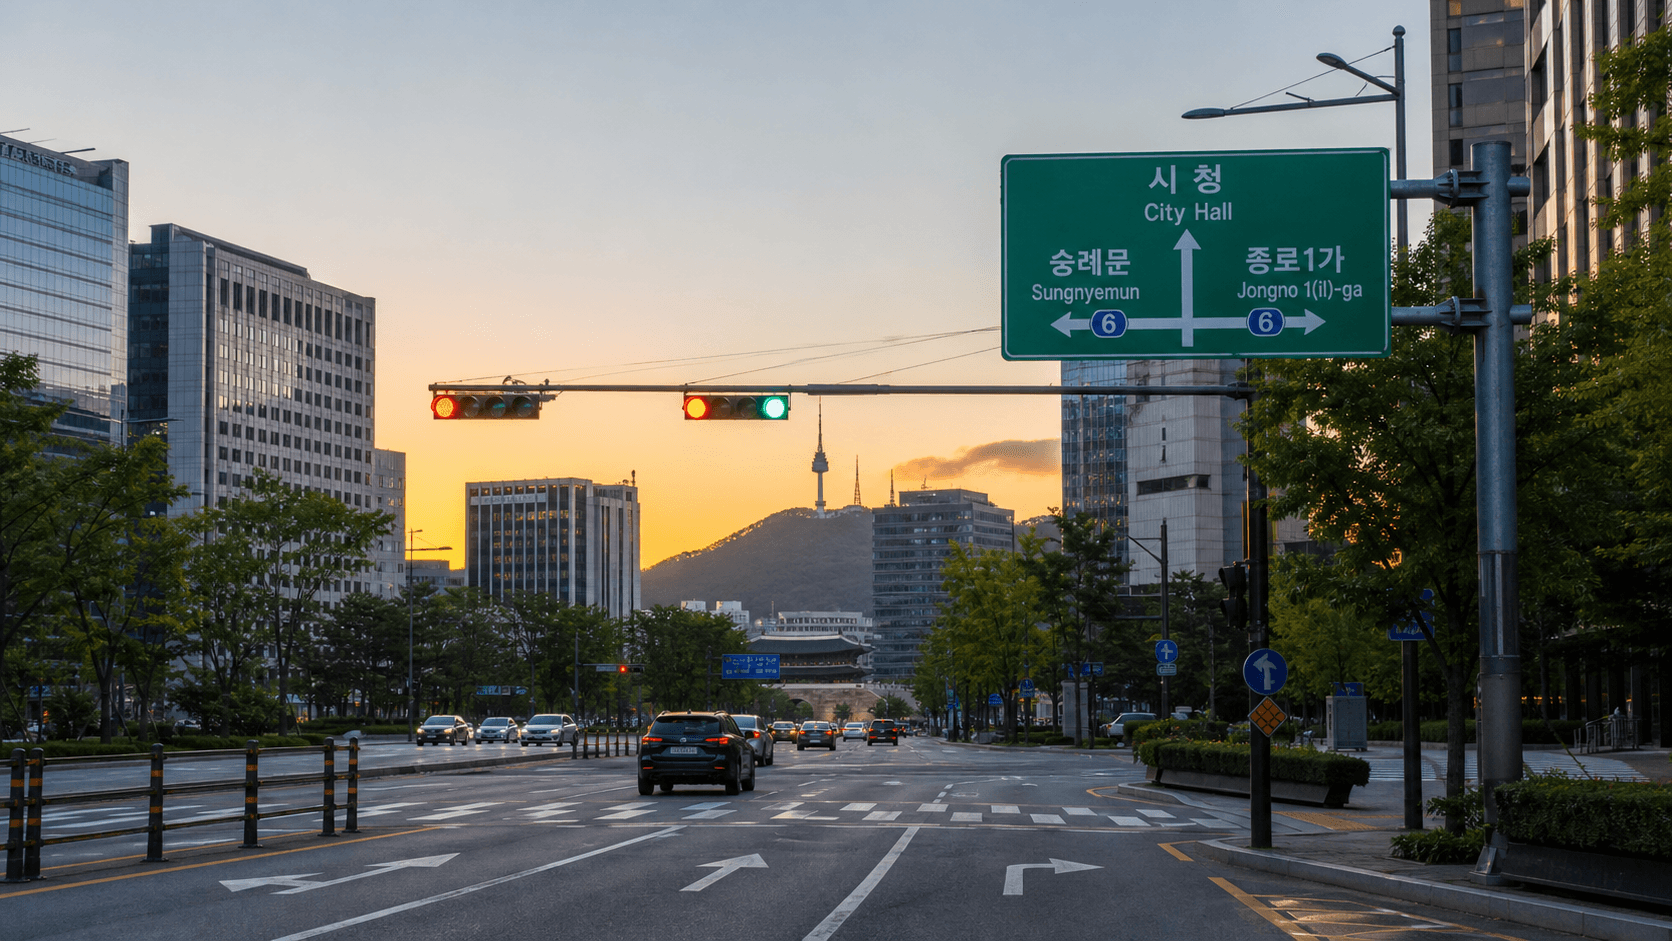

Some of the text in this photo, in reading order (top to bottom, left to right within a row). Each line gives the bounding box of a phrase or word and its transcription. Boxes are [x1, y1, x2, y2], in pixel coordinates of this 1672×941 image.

[1144, 201, 1233, 226] City Hall
[1049, 248, 1131, 277] 숭례문
[1245, 245, 1345, 275] 종로1가
[1031, 283, 1140, 305] Sungnyemun
[1237, 280, 1363, 303] Jongno 1(il)-ga
[1101, 313, 1117, 334] 6
[1257, 311, 1274, 332] 6
